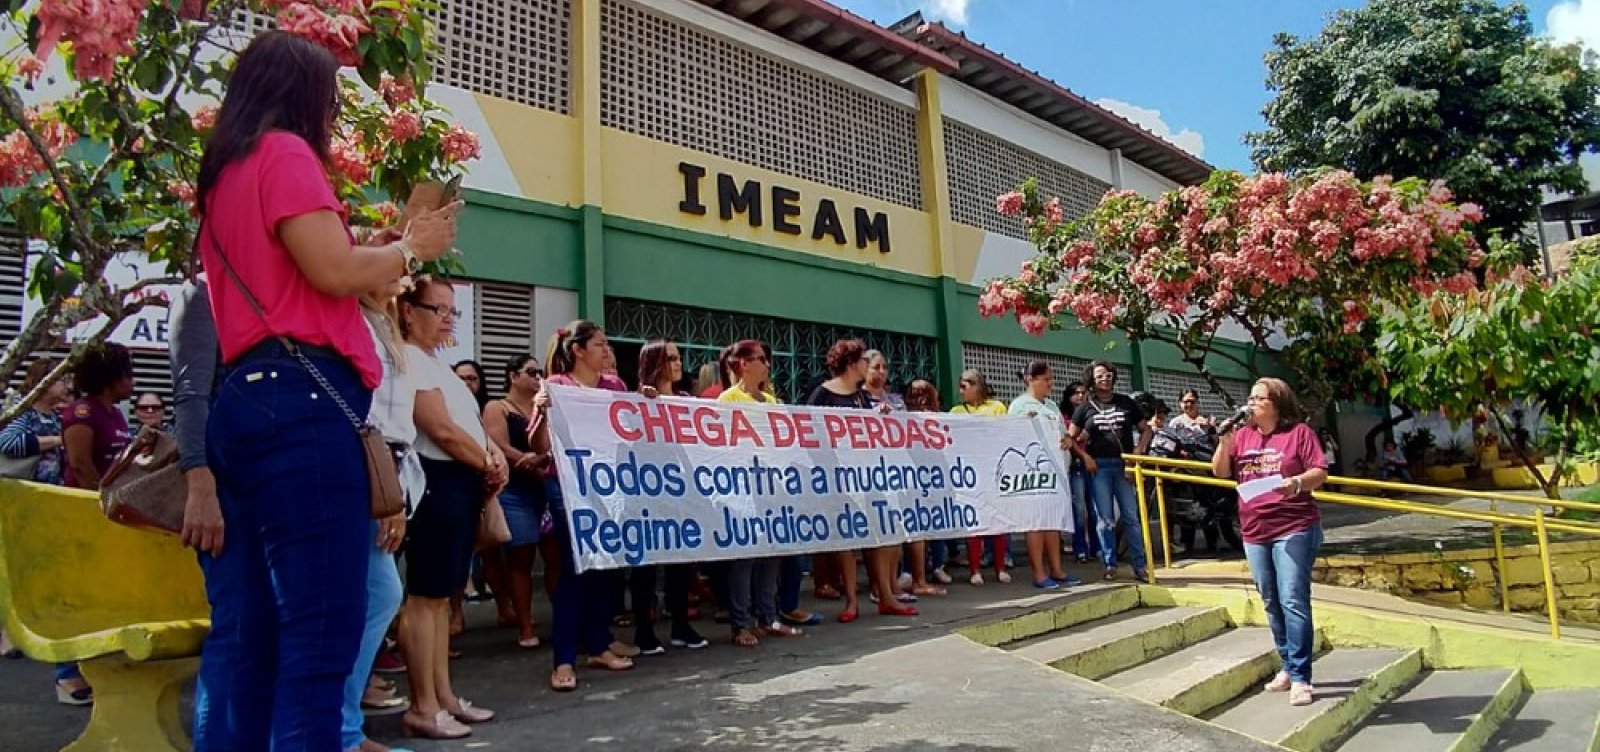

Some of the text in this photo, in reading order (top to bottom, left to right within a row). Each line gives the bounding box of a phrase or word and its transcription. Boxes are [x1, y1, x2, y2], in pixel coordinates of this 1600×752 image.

[679, 162, 890, 252] IMEAM
[608, 400, 953, 449] CHEGA DE PERDAS:
[565, 449, 977, 497] Todos contra a mudança do
[1000, 473, 1057, 492] SIMPI
[572, 497, 979, 565] Regime Jurídico de Trabalho.
